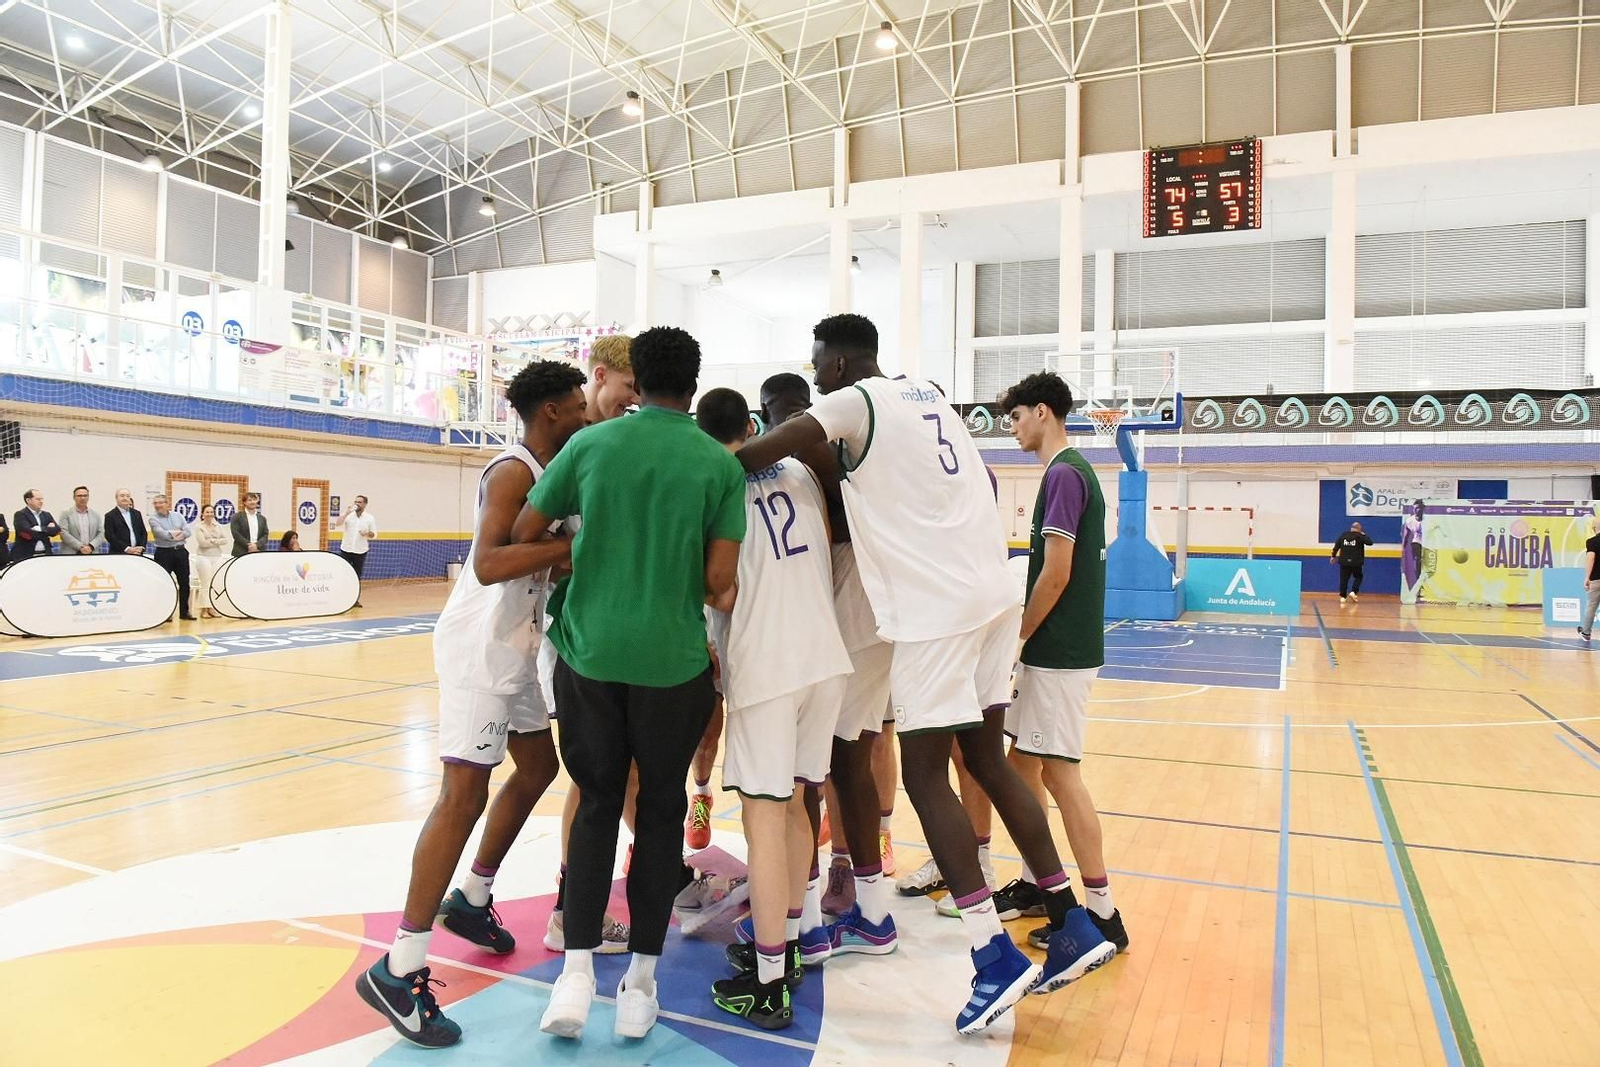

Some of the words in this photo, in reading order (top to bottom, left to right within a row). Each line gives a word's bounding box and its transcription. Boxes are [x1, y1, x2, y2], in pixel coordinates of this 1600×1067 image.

[1164, 188, 1186, 203] 74
[1220, 182, 1241, 198] 57
[1172, 212, 1184, 227] 5
[1228, 206, 1240, 222] 3
[183, 315, 201, 331] 03
[223, 324, 241, 339] 03
[922, 413, 959, 475] 3
[177, 504, 195, 518] 07
[215, 504, 233, 519] 07
[300, 506, 315, 520] 08
[754, 490, 809, 560] 12
[1484, 534, 1554, 570] CADEBA
[301, 584, 310, 594] de
[312, 584, 331, 593] vida
[1238, 598, 1276, 606] Andalucía
